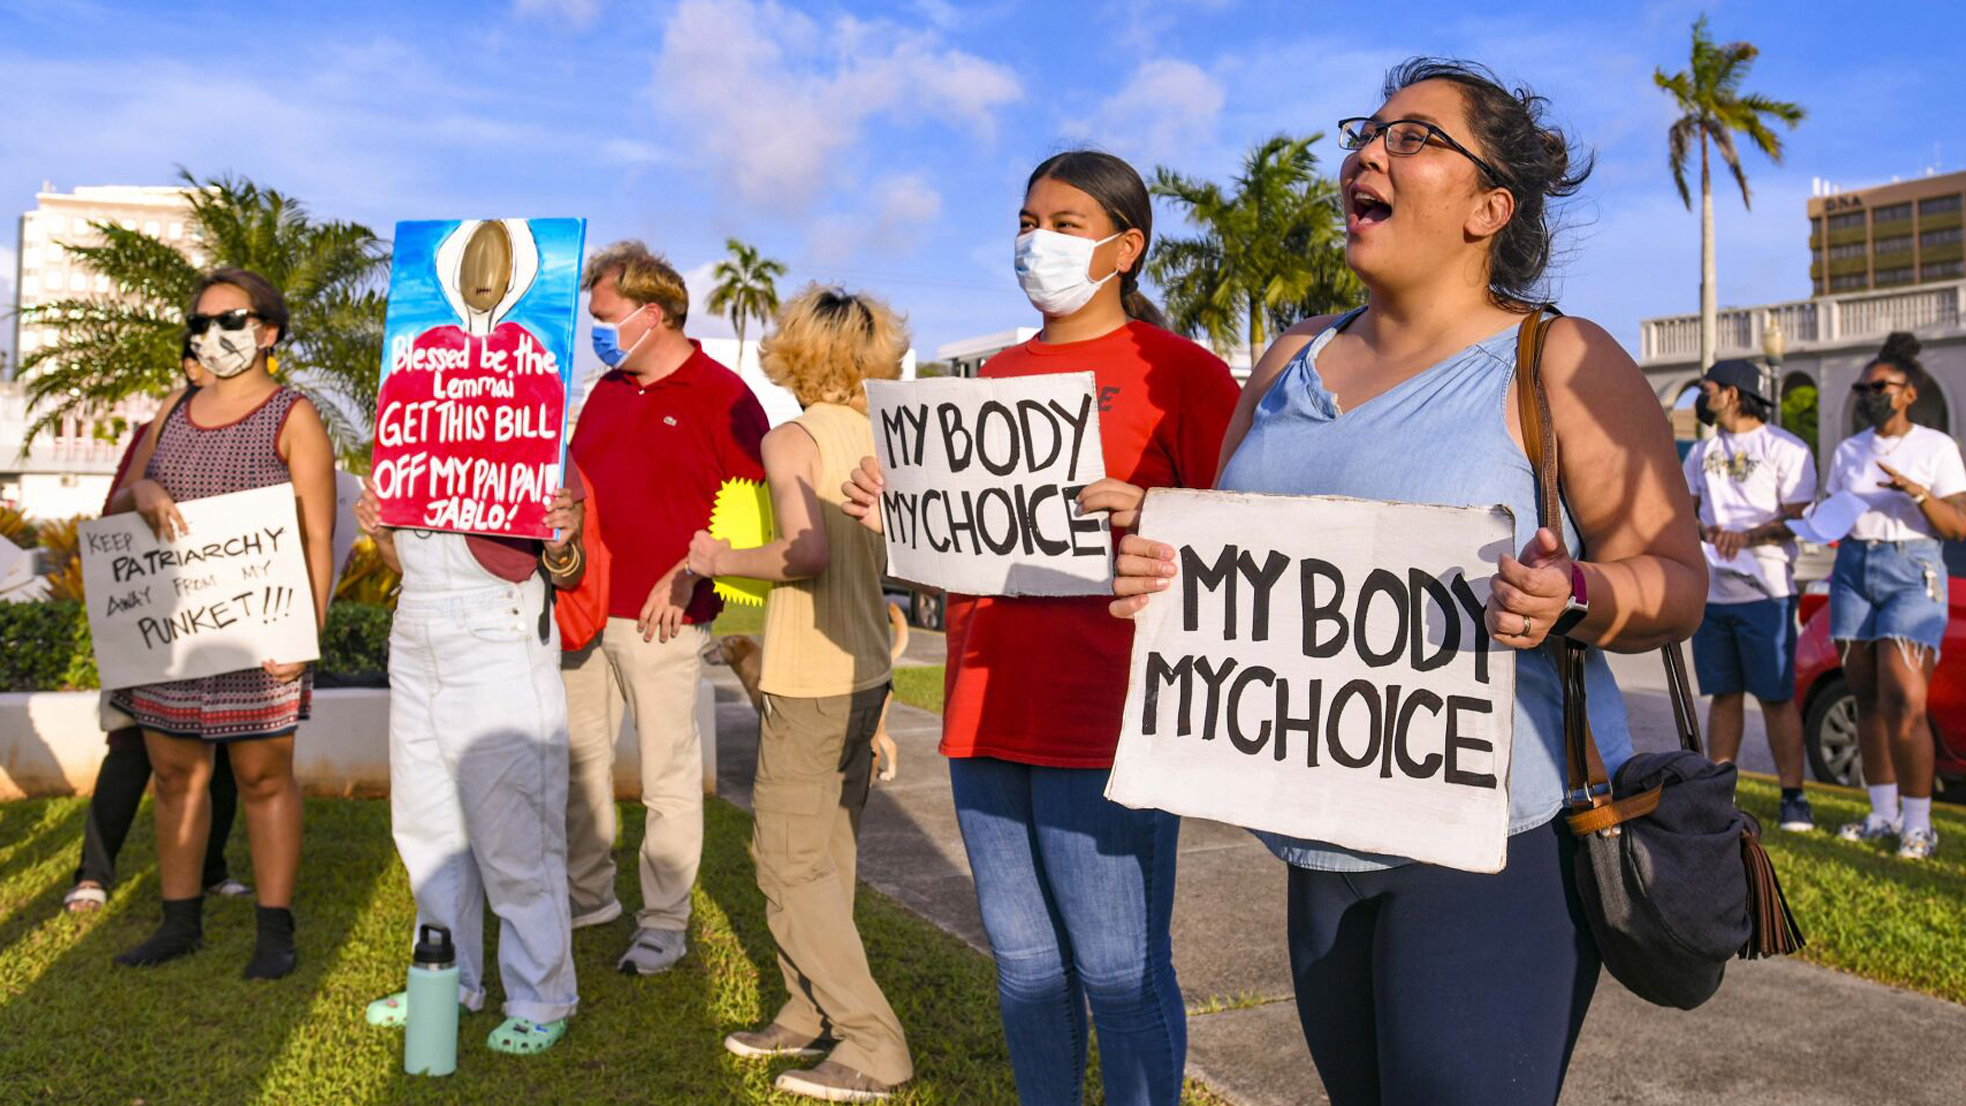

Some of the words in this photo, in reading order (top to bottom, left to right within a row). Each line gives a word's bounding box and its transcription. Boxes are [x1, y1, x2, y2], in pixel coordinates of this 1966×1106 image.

[391, 333, 470, 376] Blessed
[480, 336, 508, 372] be
[513, 333, 559, 375] the
[433, 370, 514, 400] Lemmai
[379, 400, 437, 448] GET
[435, 401, 489, 443] THIS
[495, 403, 556, 442] BILL
[881, 403, 929, 469] MY
[937, 392, 1092, 481] BODY
[373, 451, 427, 499] OFF
[429, 455, 473, 498] MY
[473, 458, 506, 503] PAI
[424, 496, 519, 531] JABLO!
[86, 532, 132, 554] KEEP
[112, 527, 285, 582] PATRIARCHY
[106, 586, 152, 617] AWAY
[173, 575, 216, 597] FROM
[242, 560, 271, 580] MY
[1180, 544, 1291, 642] MY
[1300, 557, 1490, 684] BODY
